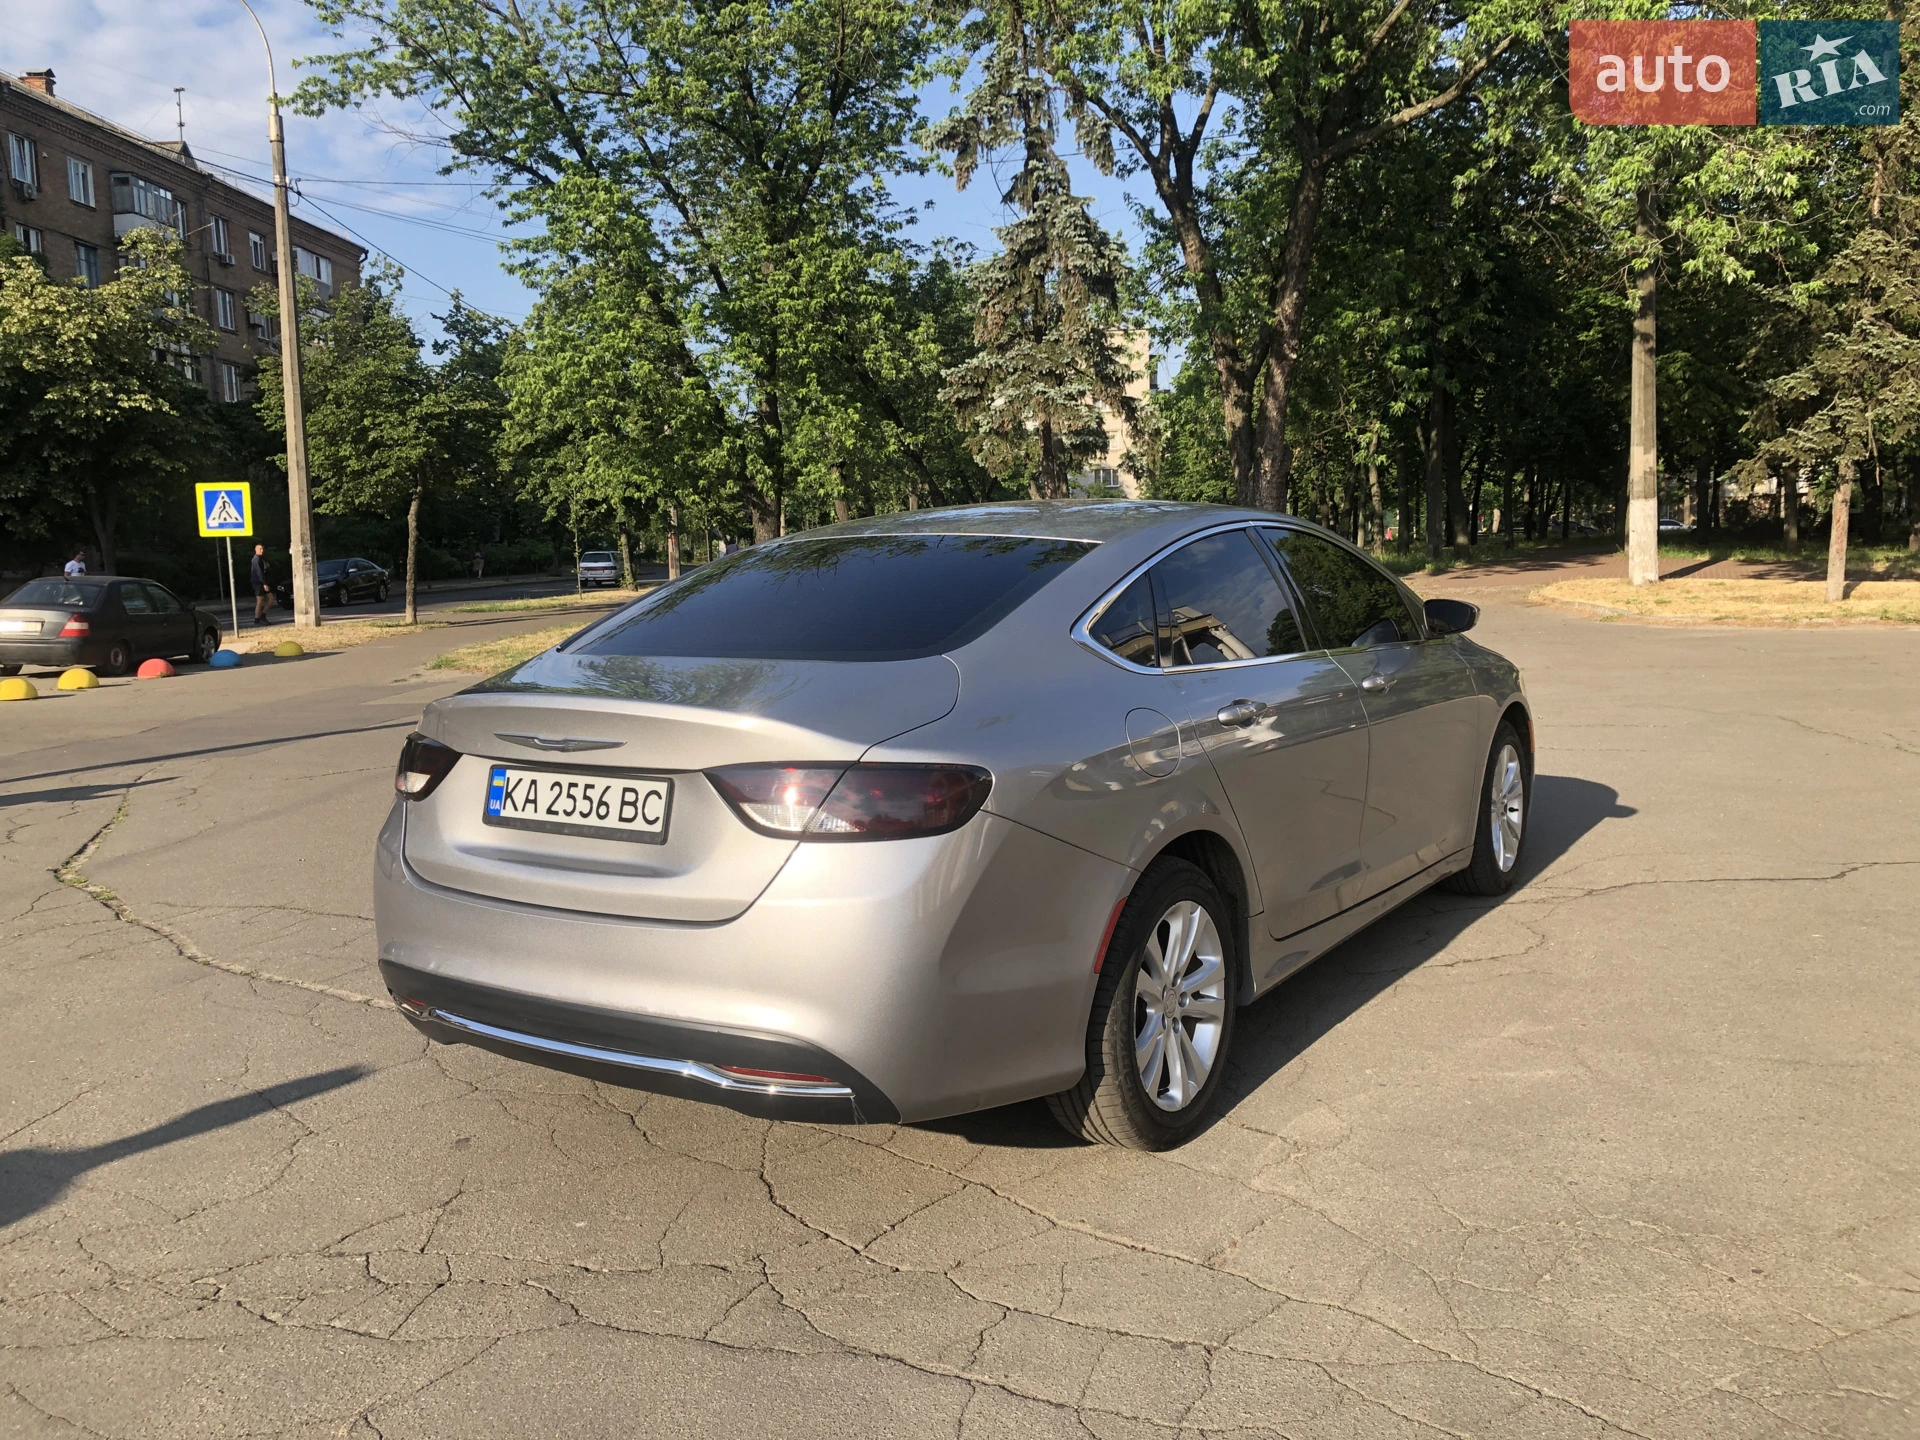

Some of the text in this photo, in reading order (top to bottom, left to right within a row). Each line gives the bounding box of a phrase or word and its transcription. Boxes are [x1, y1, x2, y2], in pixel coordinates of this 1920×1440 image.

[490, 799, 501, 810] UA
[503, 777, 663, 825] KA 2556 BC
